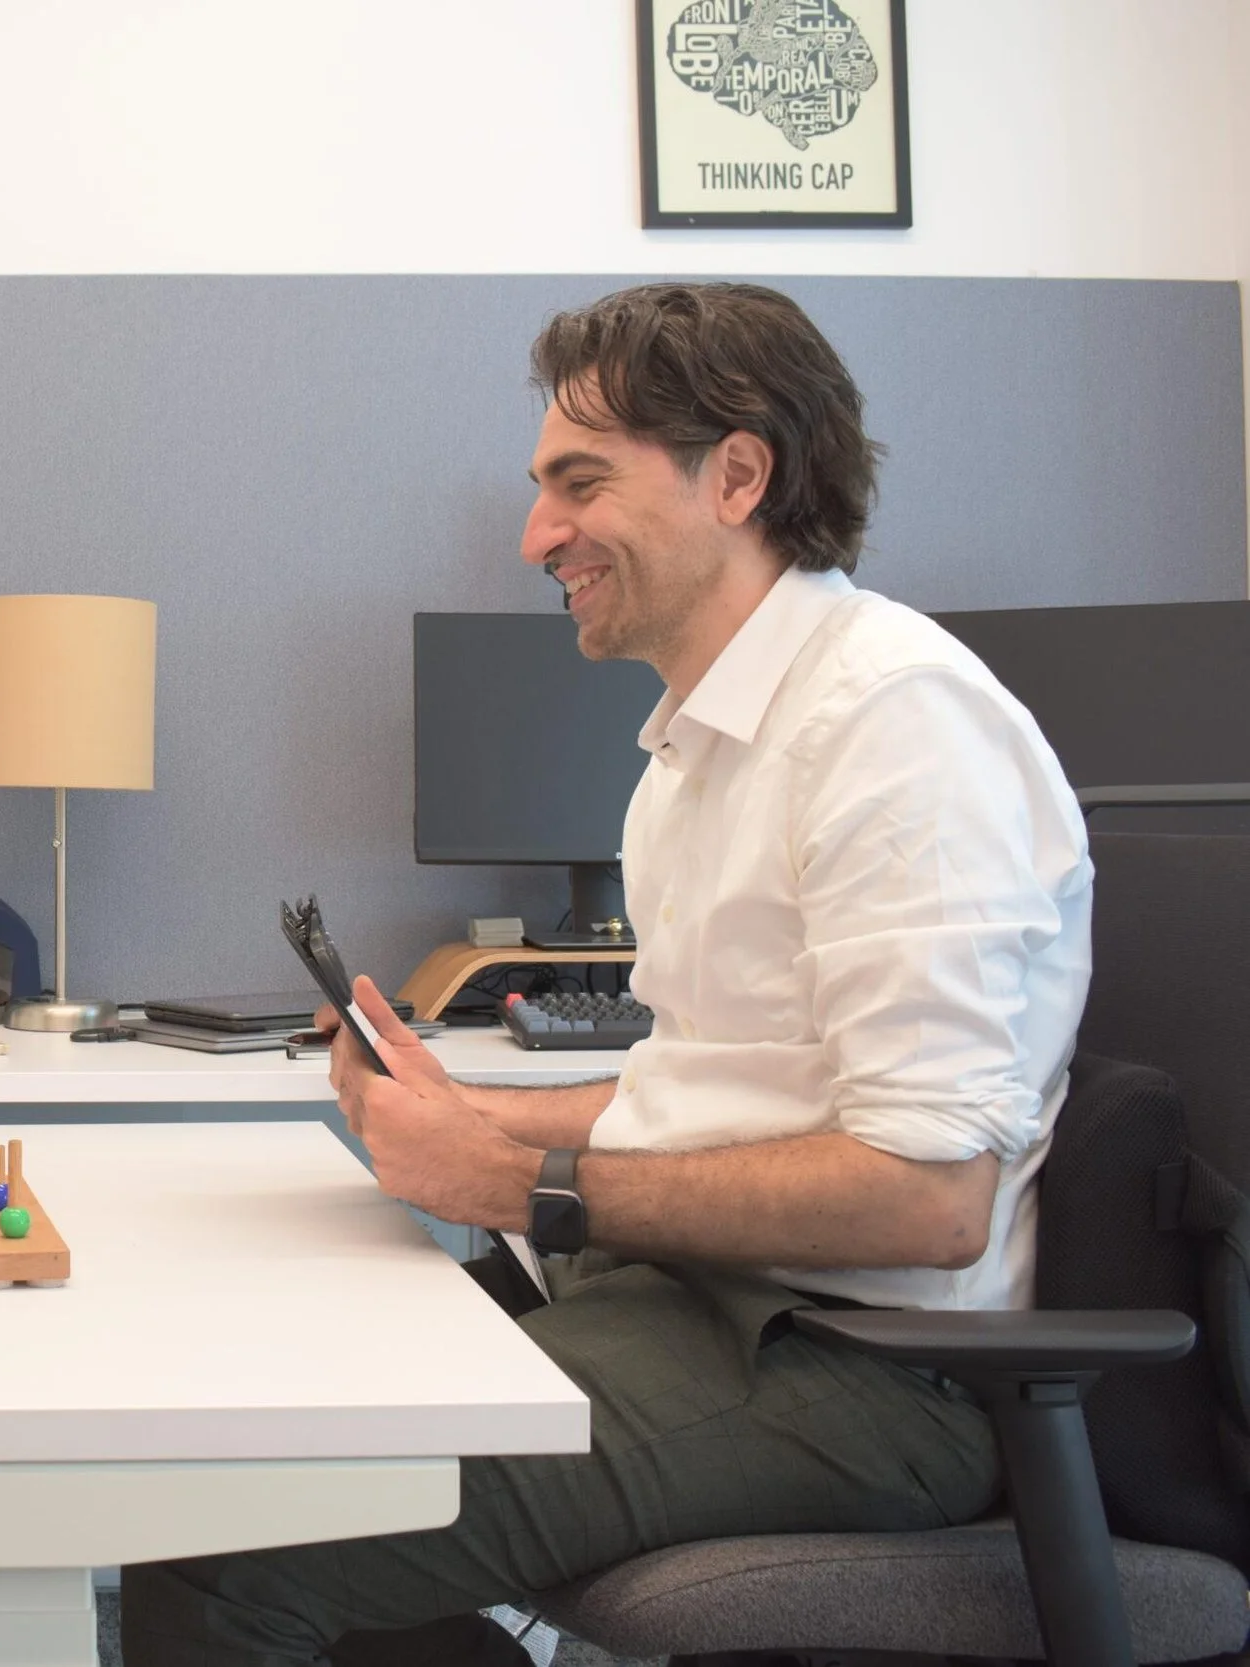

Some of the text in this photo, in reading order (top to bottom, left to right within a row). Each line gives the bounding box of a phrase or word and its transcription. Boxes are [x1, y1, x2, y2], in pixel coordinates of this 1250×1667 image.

[673, 23, 738, 88] LOBE
[725, 52, 834, 94] TEMPORAL
[698, 162, 854, 190] THINKING CAP
